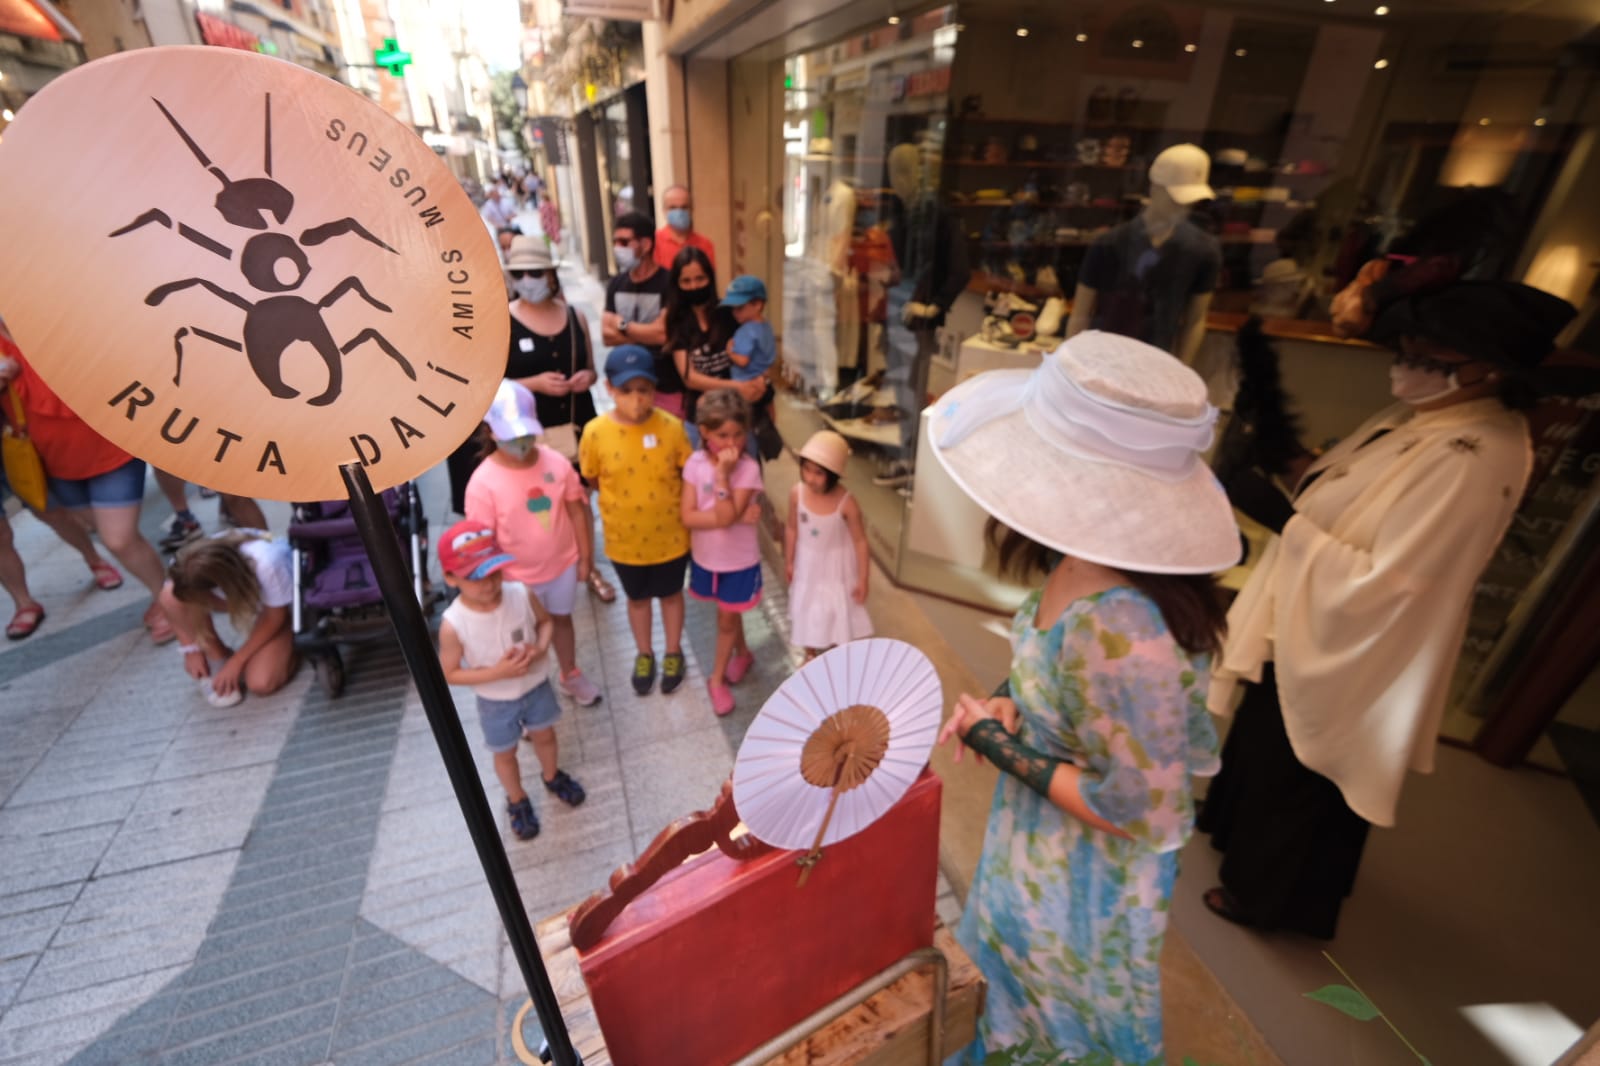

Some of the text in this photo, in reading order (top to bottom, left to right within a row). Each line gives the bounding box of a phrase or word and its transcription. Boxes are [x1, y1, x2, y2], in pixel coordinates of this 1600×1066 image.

[325, 117, 475, 340] AMICS MUSEUS
[107, 360, 470, 475] RUTA DALÍ
